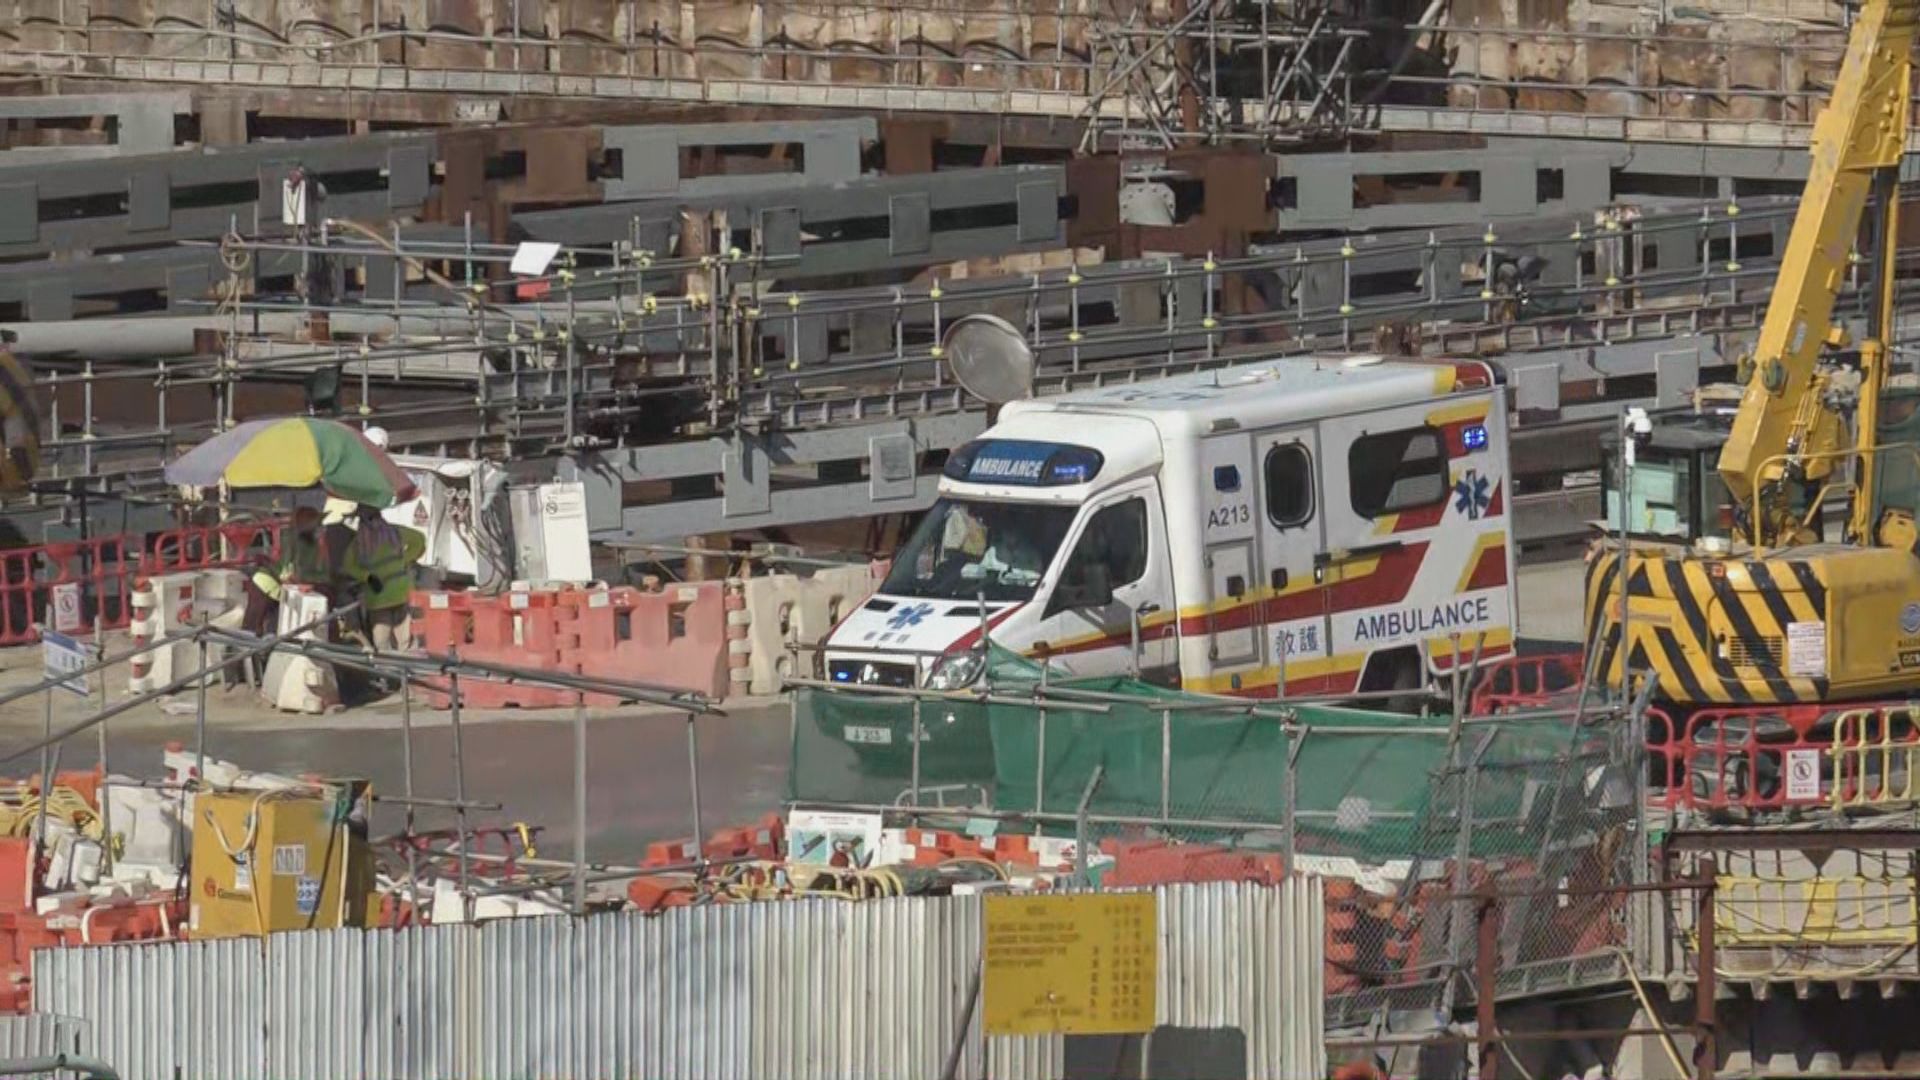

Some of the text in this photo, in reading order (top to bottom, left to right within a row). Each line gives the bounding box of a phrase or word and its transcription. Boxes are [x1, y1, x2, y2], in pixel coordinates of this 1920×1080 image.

[970, 457, 1044, 478] AMBULANCE
[1207, 504, 1250, 529] A213
[1354, 597, 1489, 642] AMBULANCE
[1275, 625, 1318, 657] 救護
